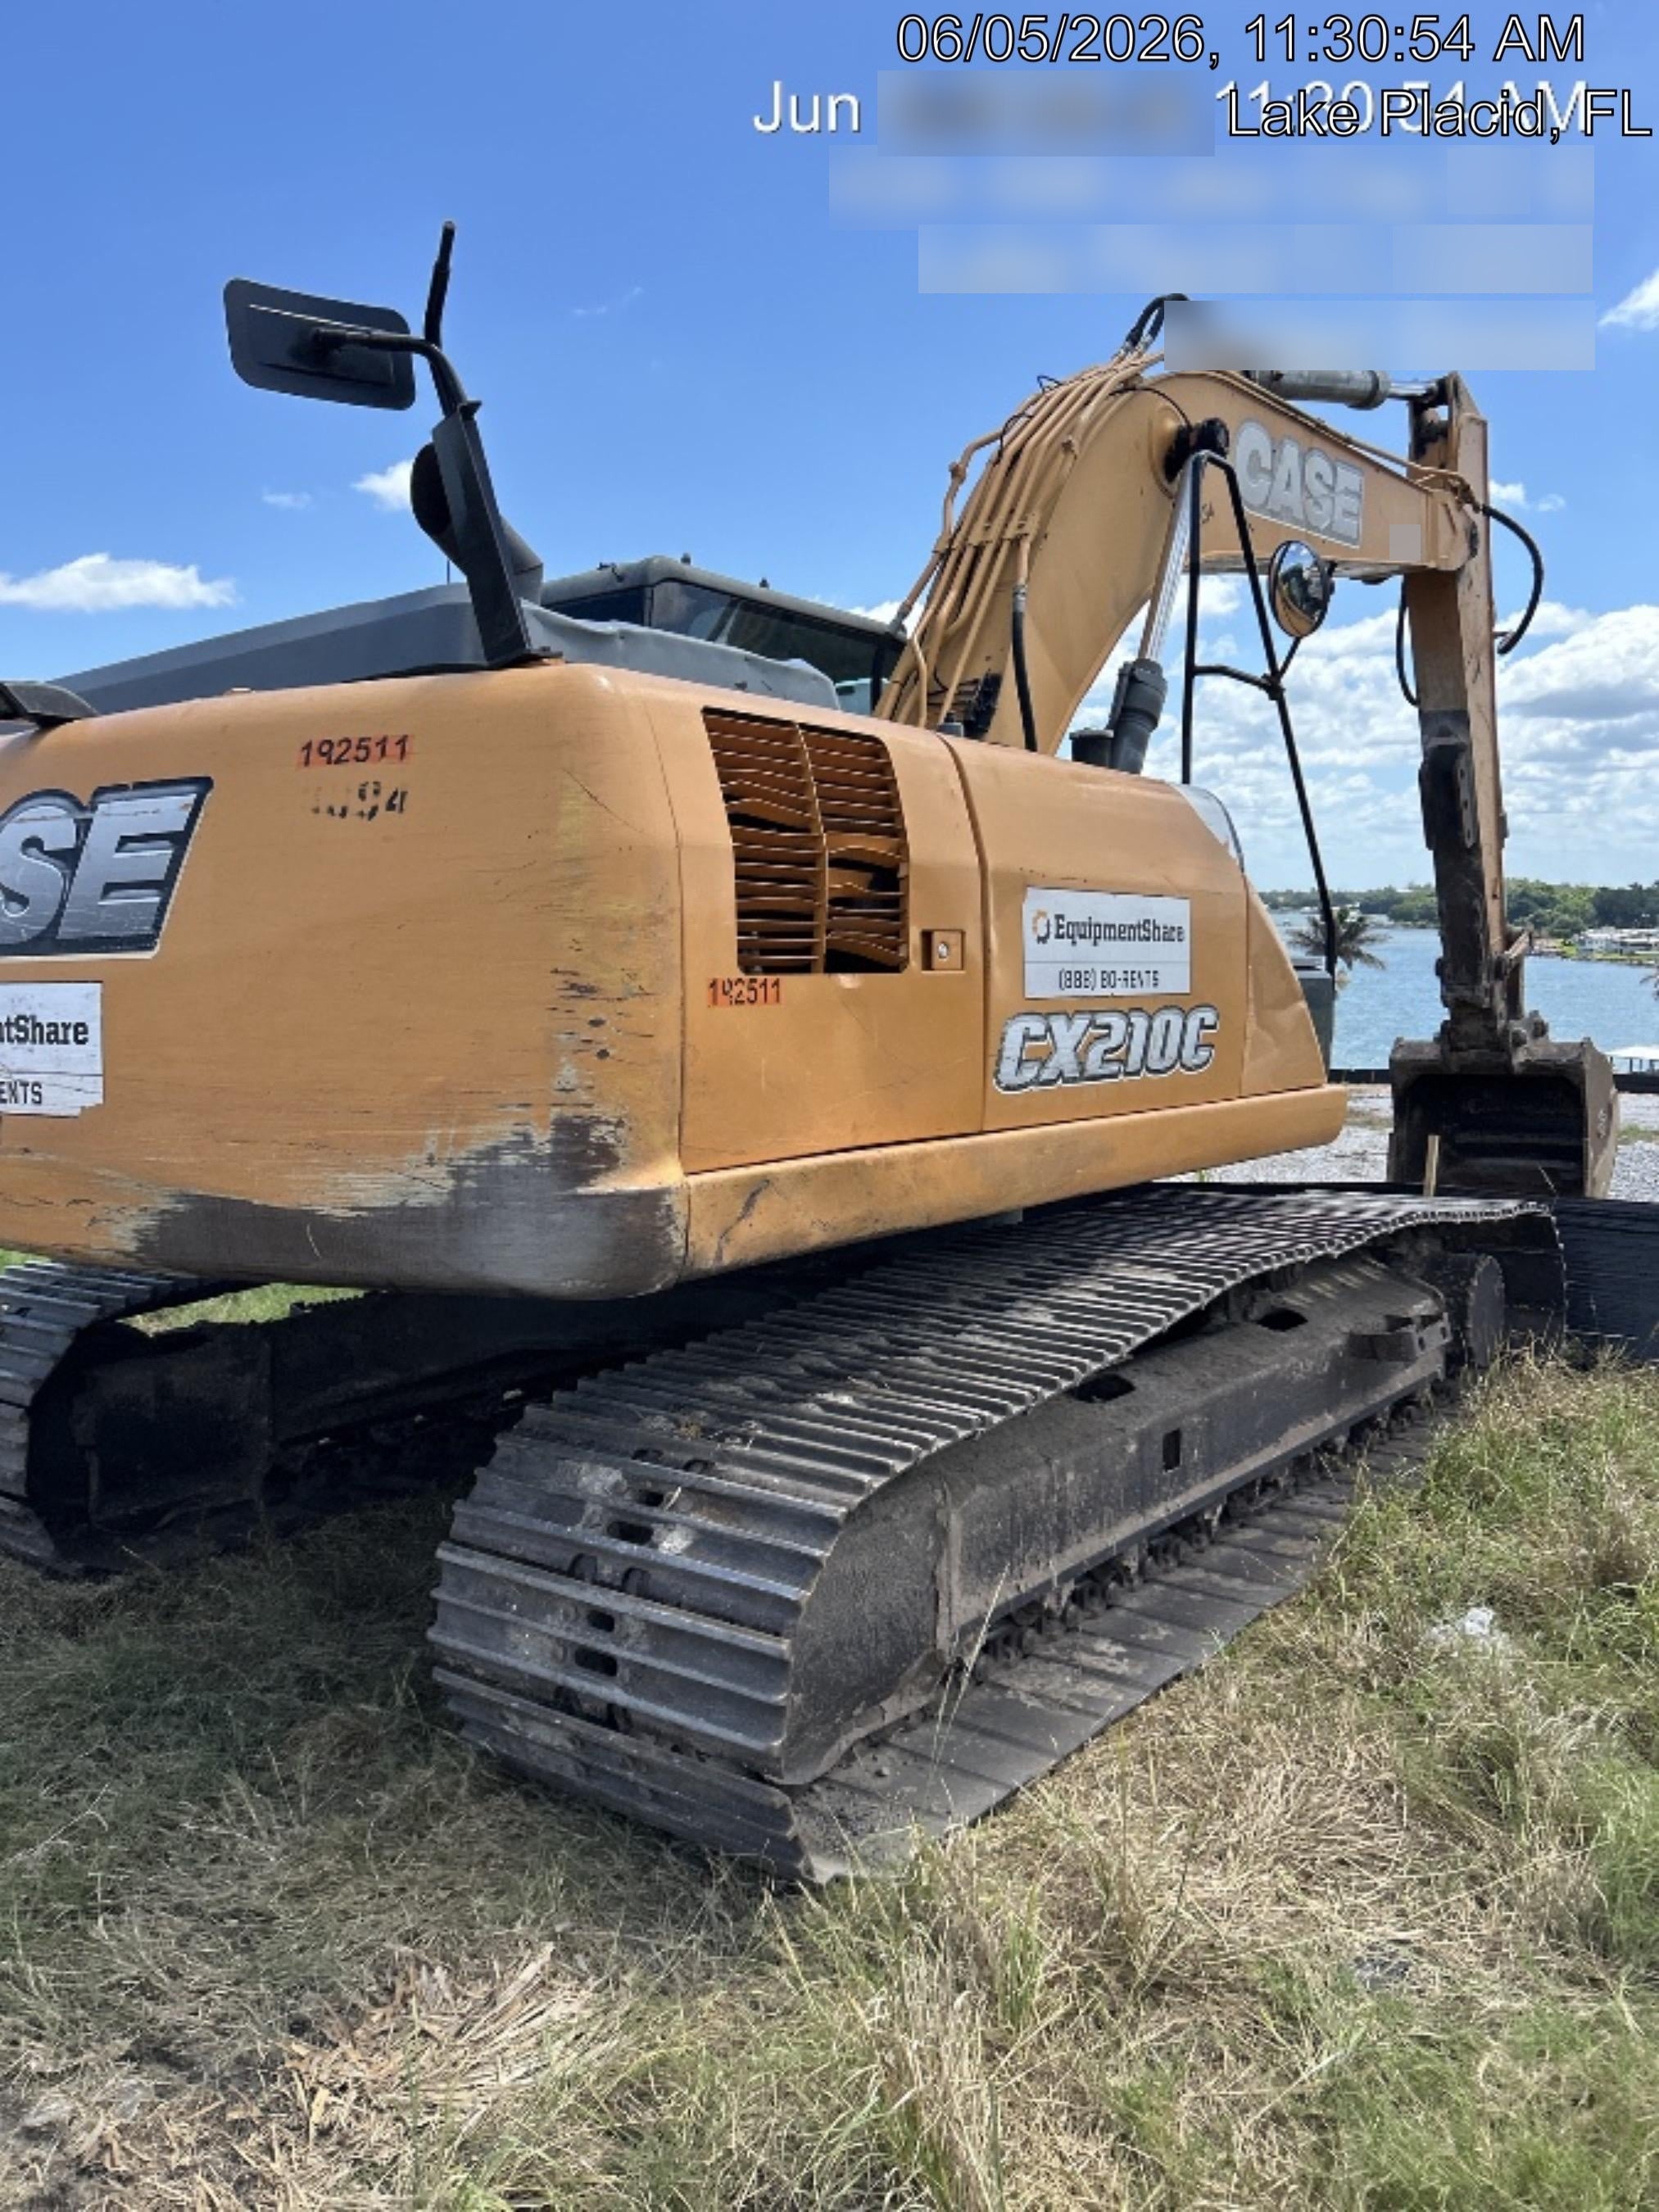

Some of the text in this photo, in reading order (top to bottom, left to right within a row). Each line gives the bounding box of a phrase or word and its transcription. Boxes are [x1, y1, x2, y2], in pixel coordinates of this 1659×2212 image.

[1234, 419, 1365, 544] CASE
[301, 734, 409, 767] 192511
[1054, 913, 1185, 947] EquipmentShare
[994, 1004, 1220, 1093] CX210C
